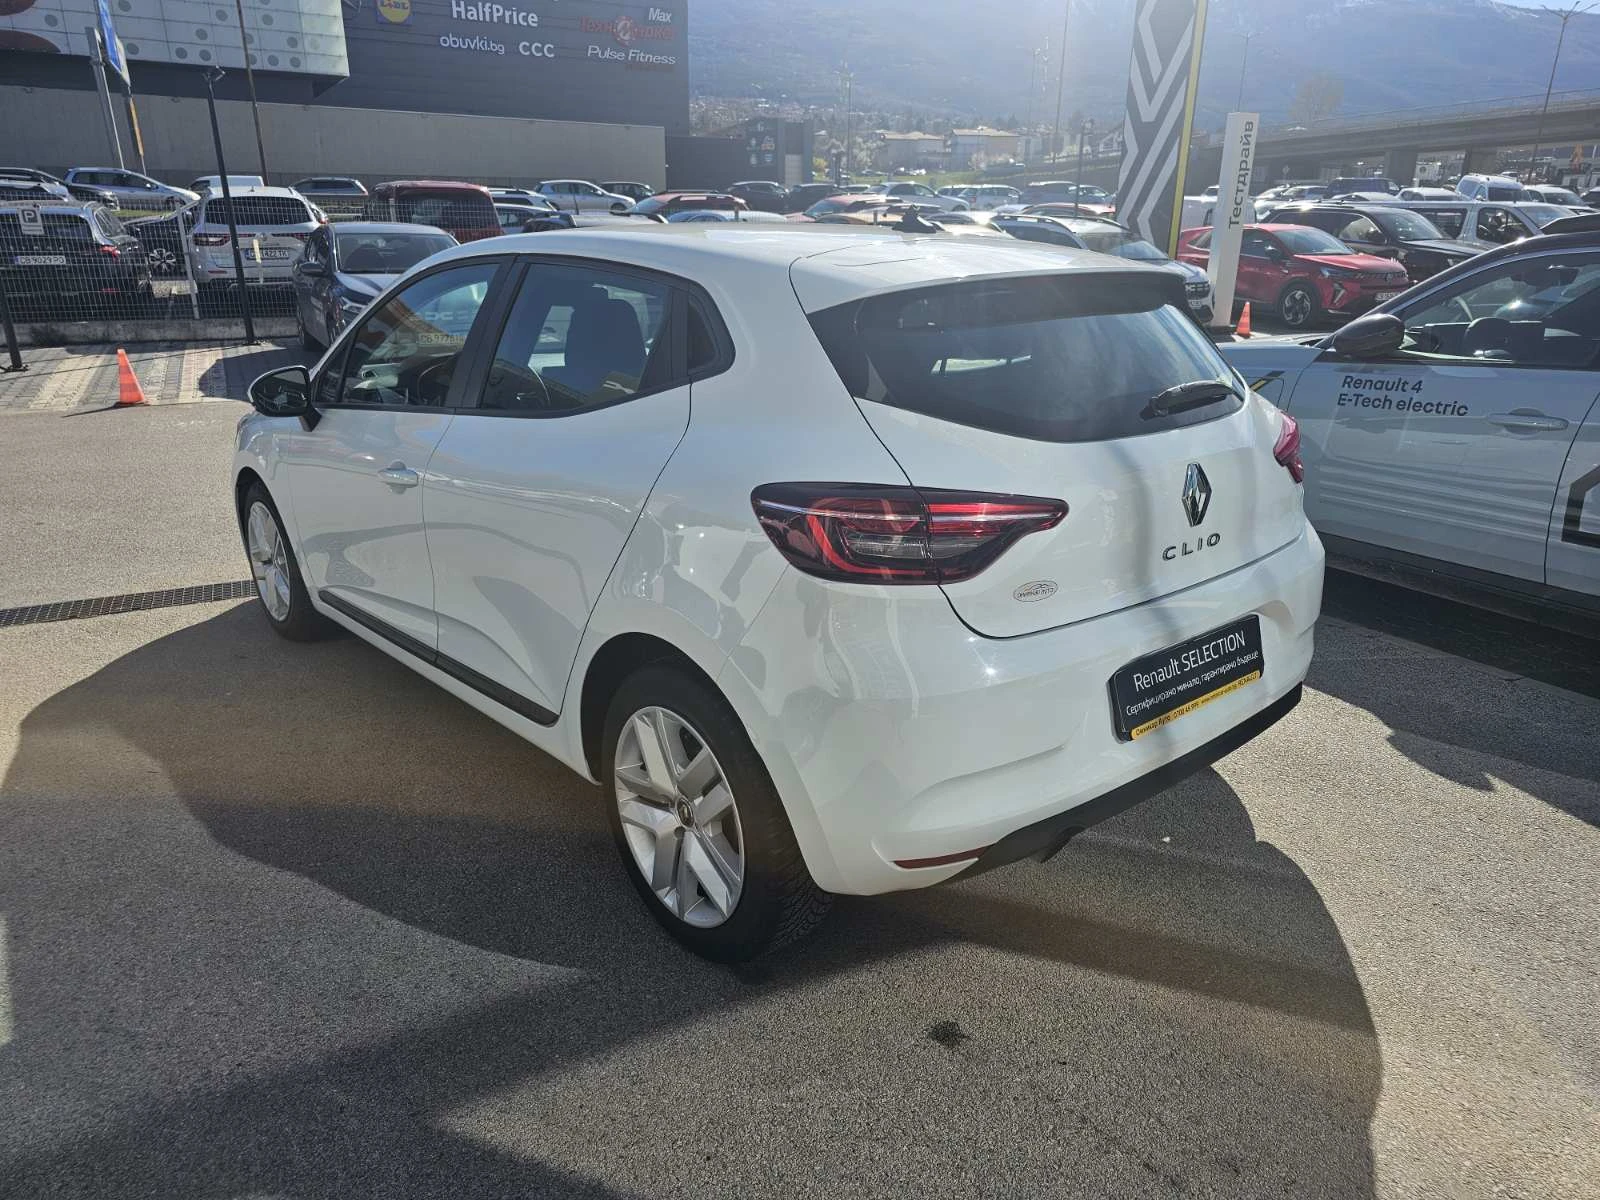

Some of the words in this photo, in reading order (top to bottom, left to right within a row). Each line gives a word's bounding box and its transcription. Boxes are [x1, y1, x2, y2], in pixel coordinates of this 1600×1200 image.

[451, 0, 539, 27] HalfPrice
[648, 7, 672, 23] Max
[439, 32, 505, 55] obuvki.bg
[519, 41, 555, 58] CCC
[587, 45, 625, 61] Pulse
[628, 49, 676, 65] Fitness
[1228, 120, 1255, 229] Тестдрайв
[1341, 375, 1408, 393] Renault
[1411, 380, 1424, 394] 4
[1337, 393, 1392, 410] E-Tech
[1396, 397, 1469, 417] electric
[1162, 532, 1221, 561] CLIO
[1133, 658, 1181, 692] Renault
[1181, 630, 1246, 671] SELECTION
[1126, 686, 1177, 717] Сертифицирано
[1200, 660, 1237, 684] гарантирано
